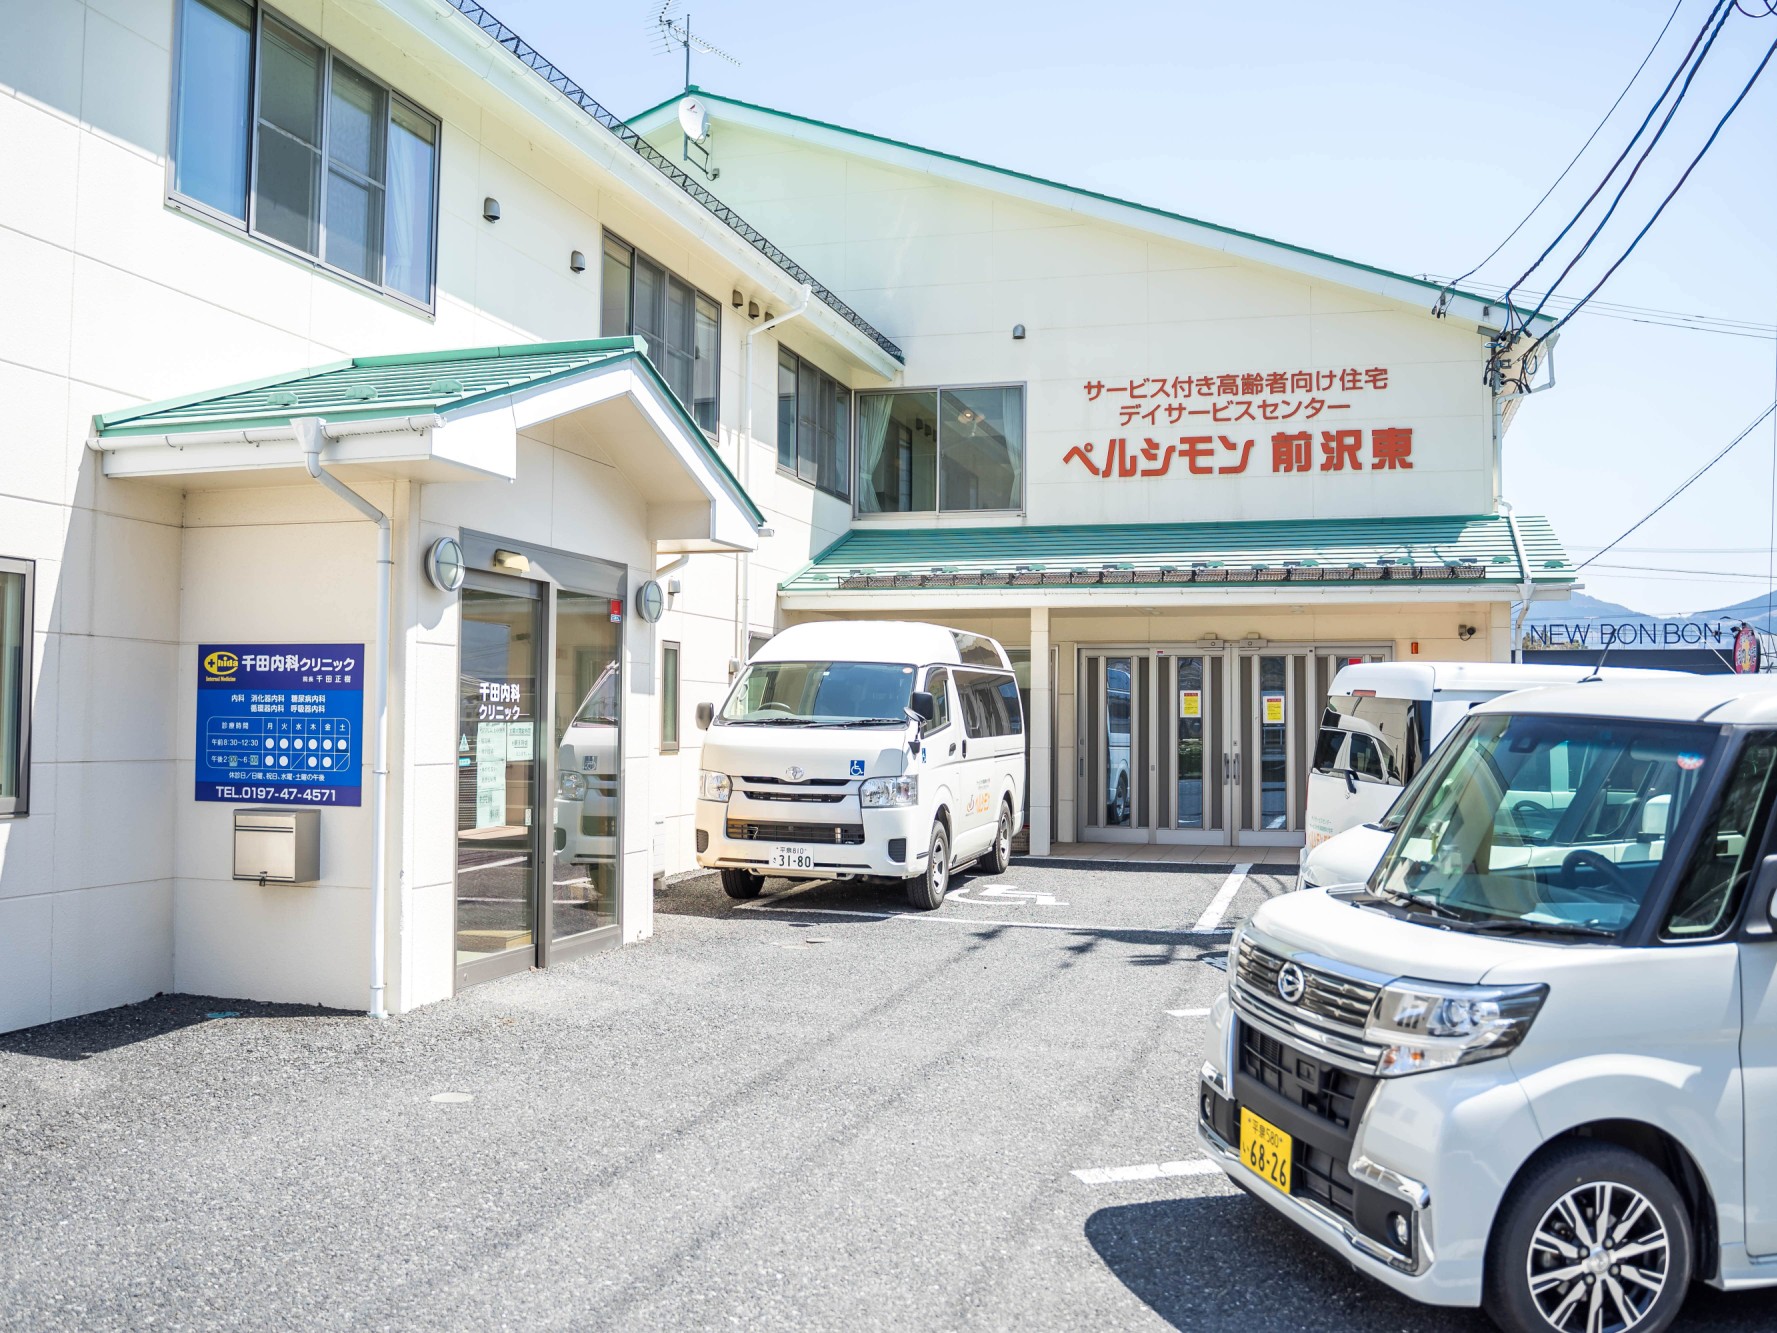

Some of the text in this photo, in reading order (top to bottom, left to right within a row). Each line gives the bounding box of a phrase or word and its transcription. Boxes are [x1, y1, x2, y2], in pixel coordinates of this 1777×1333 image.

[1084, 367, 1388, 401] サービス付き高齢者向け住宅
[1120, 397, 1351, 426] デイサービスセンター
[1062, 428, 1414, 478] ペルシモン 前沢東
[1530, 622, 1722, 645] NEW BON BON
[241, 655, 355, 672] 千田内科クリニック
[231, 694, 244, 702] 内科
[251, 694, 285, 702] 消化器内科
[479, 682, 520, 703] 千田内科
[290, 705, 325, 713] 呼吸器内科
[479, 705, 520, 720] クリニック
[222, 722, 249, 730] 診療時間
[216, 786, 336, 801] TEL.0197-47-4571
[779, 855, 811, 868] 31-80
[1250, 1140, 1286, 1186] 68-26
